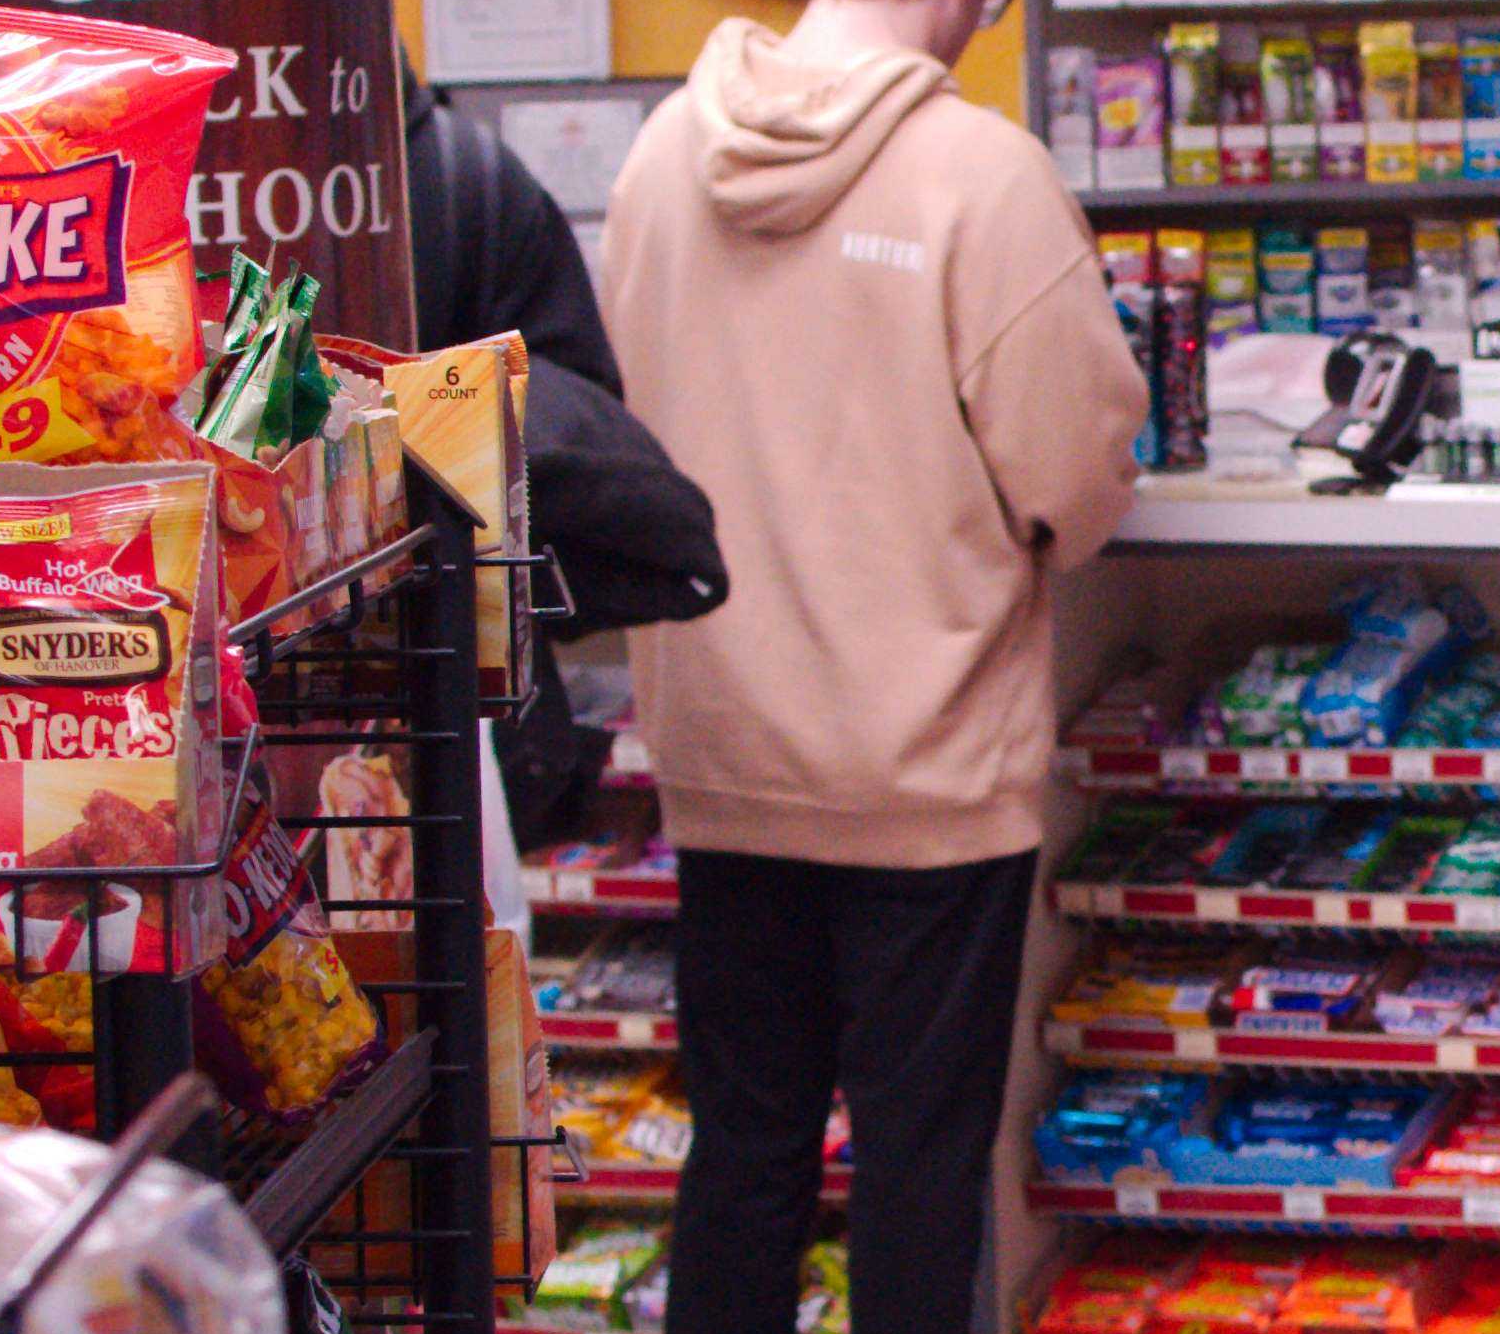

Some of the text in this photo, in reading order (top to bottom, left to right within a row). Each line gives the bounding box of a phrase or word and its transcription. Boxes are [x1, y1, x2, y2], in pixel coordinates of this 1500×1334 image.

[329, 62, 371, 114] to
[445, 364, 461, 387] 6
[428, 386, 479, 401] COUNT
[20, 518, 68, 537] SIZE!
[45, 558, 87, 579] Hot
[81, 572, 143, 596] Wing
[2, 630, 151, 662] SNYDER'S
[34, 658, 121, 674] OF HANOVER
